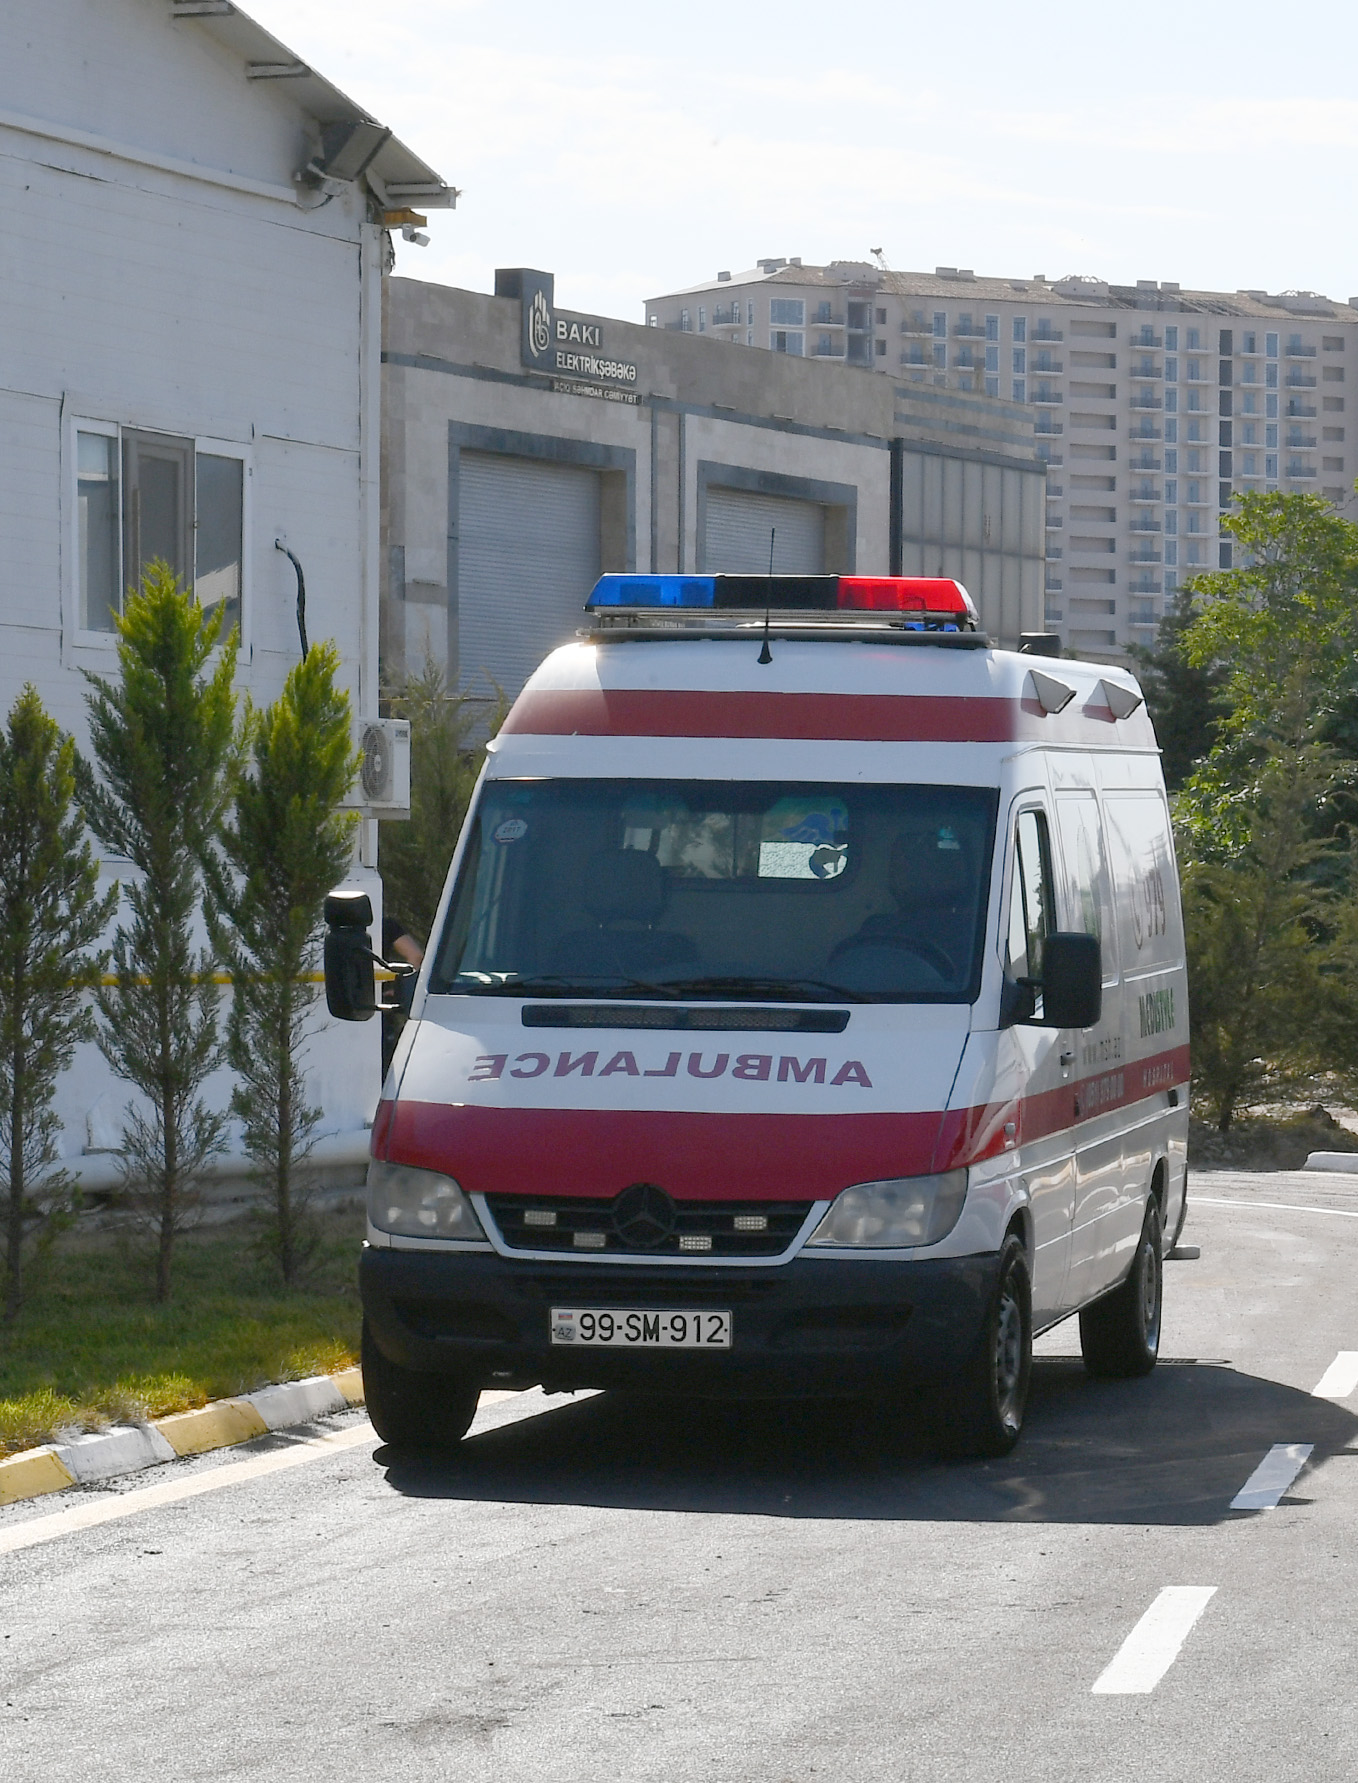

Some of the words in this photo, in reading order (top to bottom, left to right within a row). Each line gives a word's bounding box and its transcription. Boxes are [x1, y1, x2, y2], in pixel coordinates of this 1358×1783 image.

[556, 320, 600, 346] BAKI
[556, 351, 636, 381] ELEKTRİKŞƏBƏKƏ
[557, 1327, 572, 1338] AZ
[580, 1313, 724, 1343] 99-SM-912
